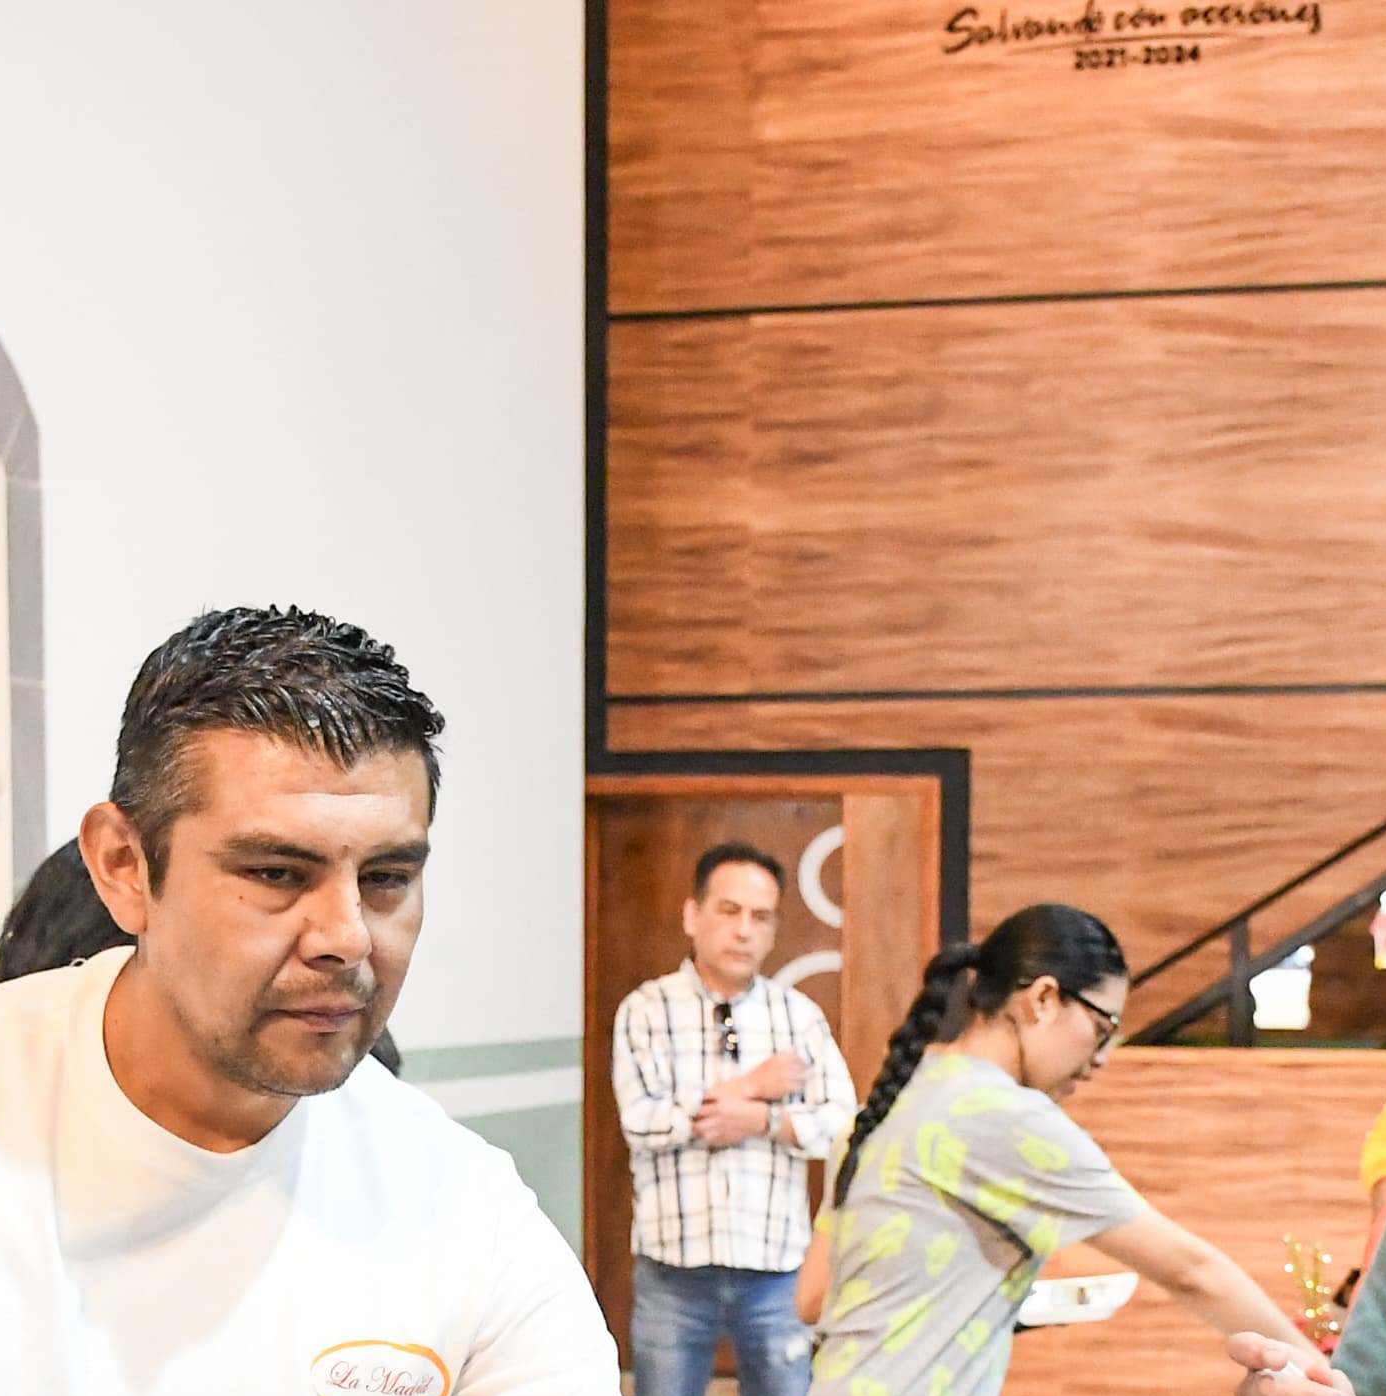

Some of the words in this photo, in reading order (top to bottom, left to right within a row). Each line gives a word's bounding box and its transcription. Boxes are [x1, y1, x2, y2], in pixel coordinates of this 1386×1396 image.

[942, 0, 1103, 54] Salvando
[1073, 45, 1201, 70] 2021-2024
[325, 1360, 360, 1390] La
